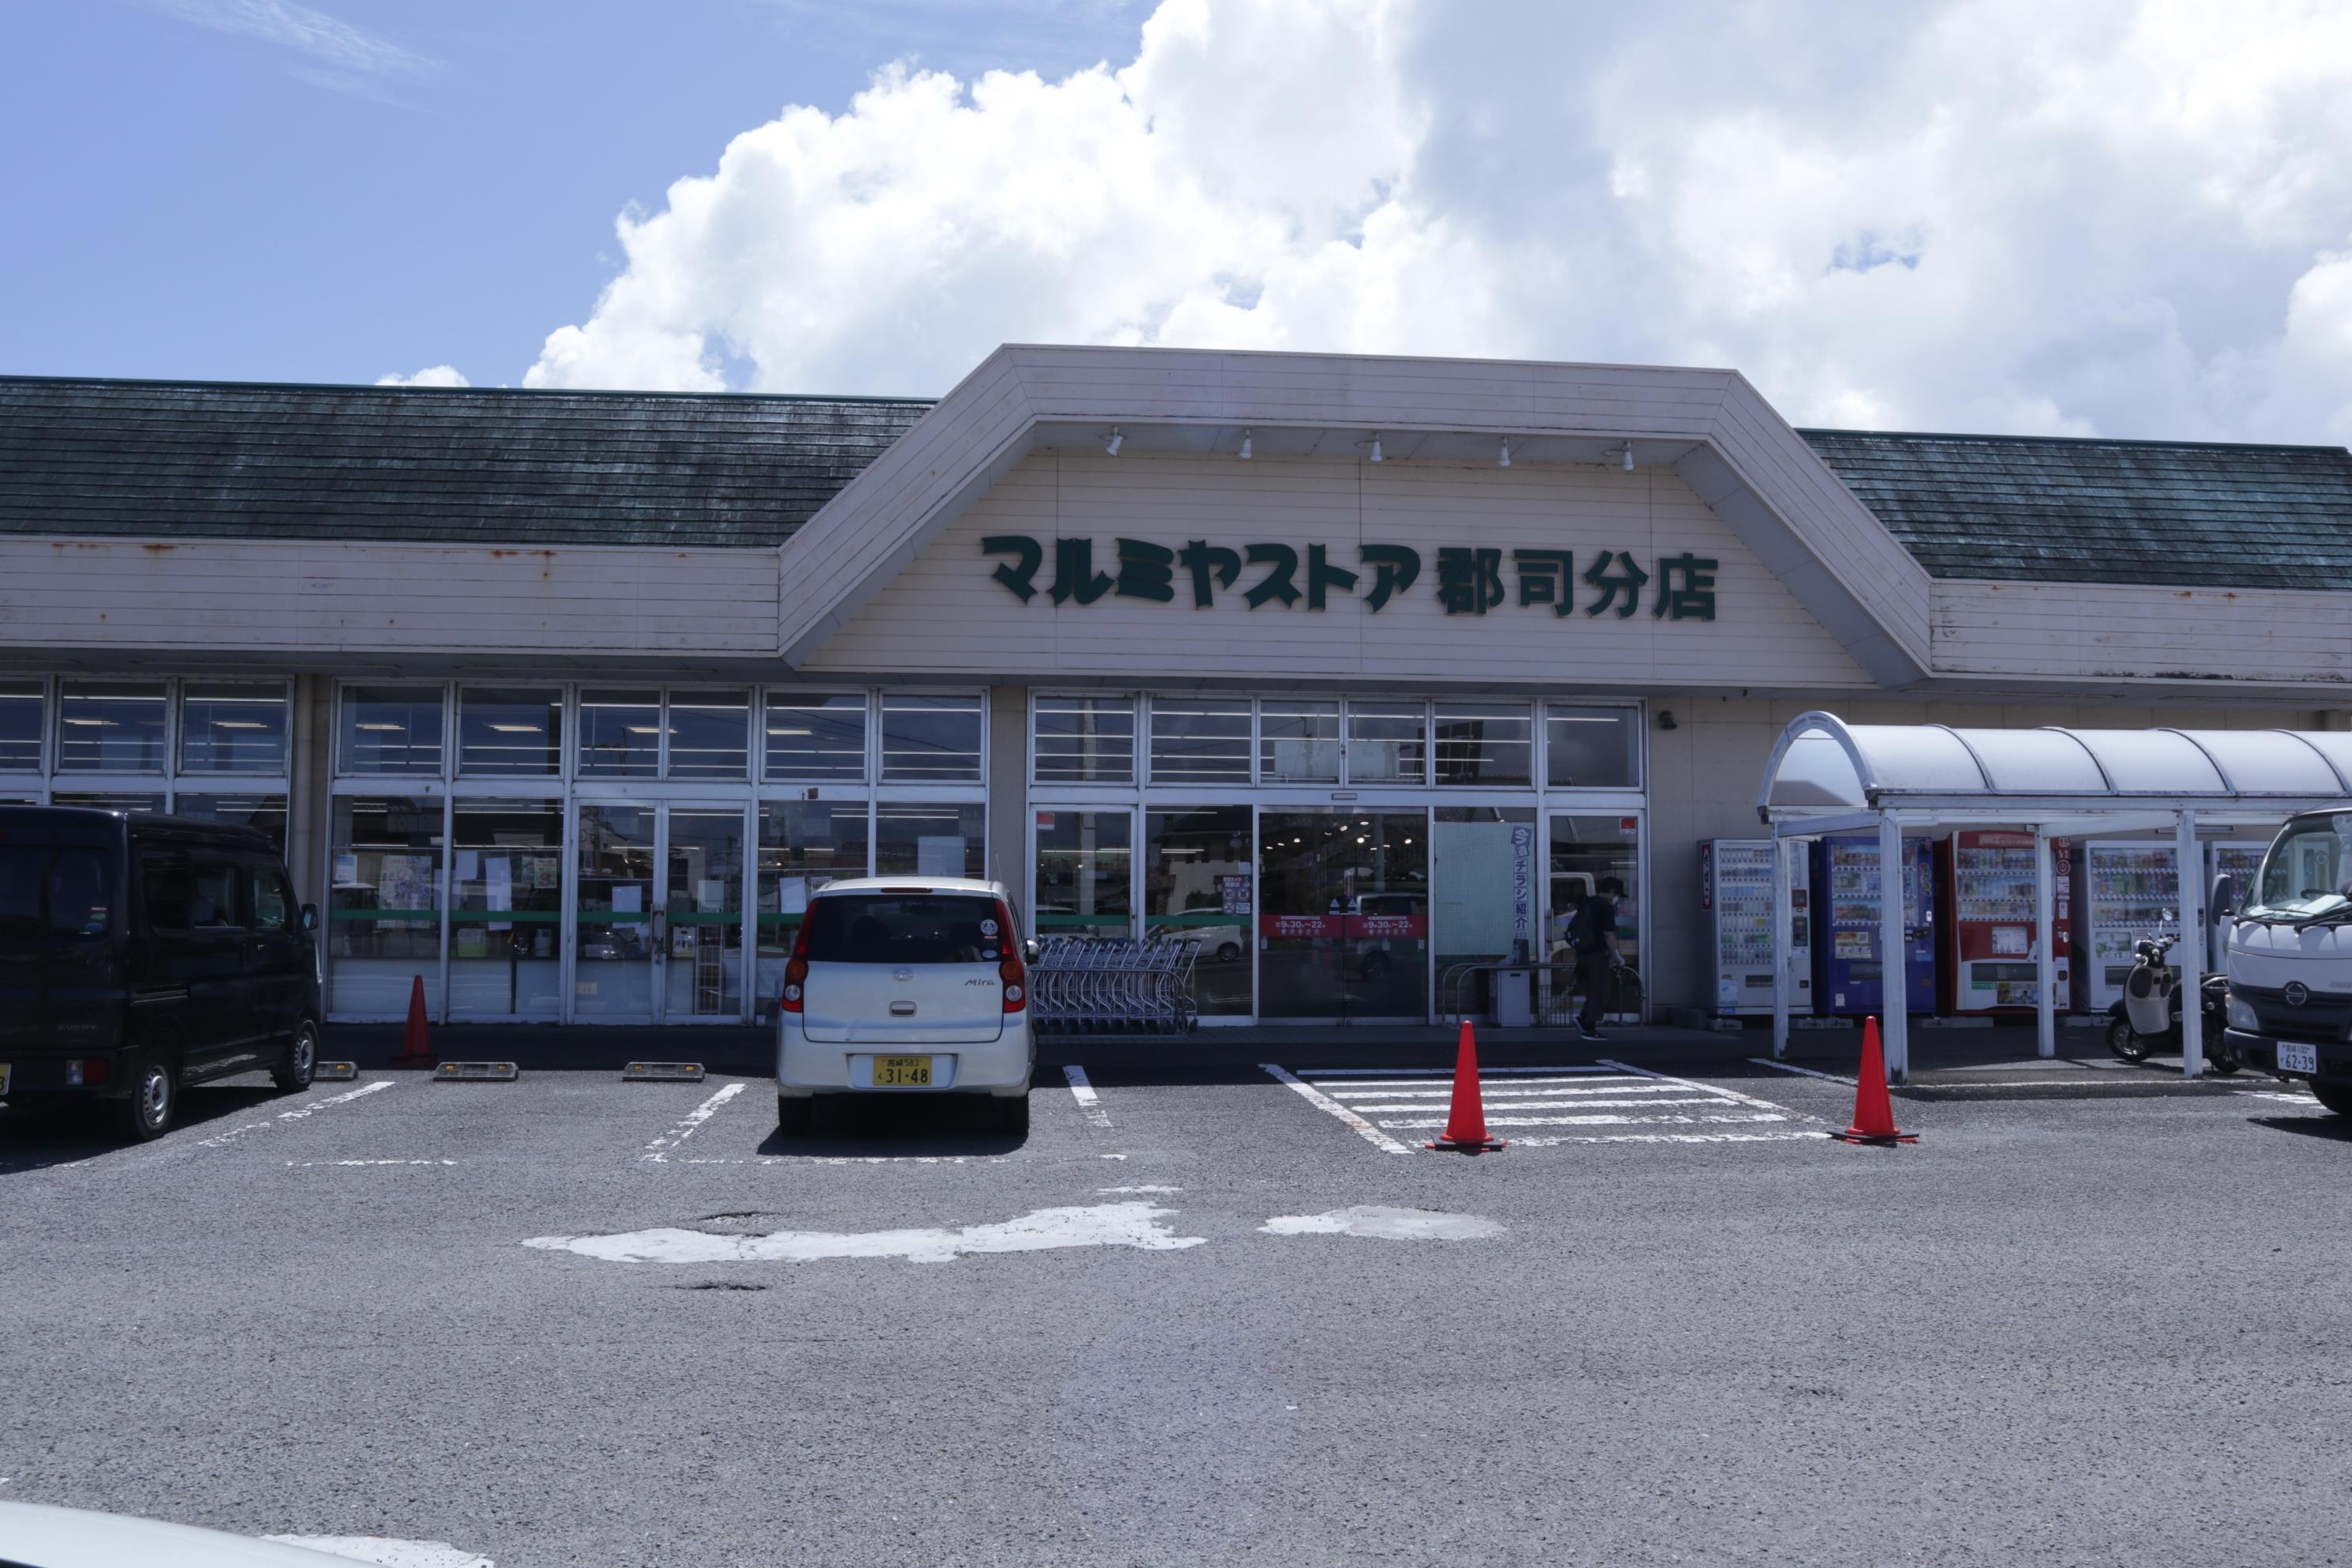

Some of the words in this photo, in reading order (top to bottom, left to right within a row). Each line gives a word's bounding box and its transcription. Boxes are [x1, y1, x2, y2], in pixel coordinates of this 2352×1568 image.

[981, 537, 1719, 621] マルミヤストア郡司分店
